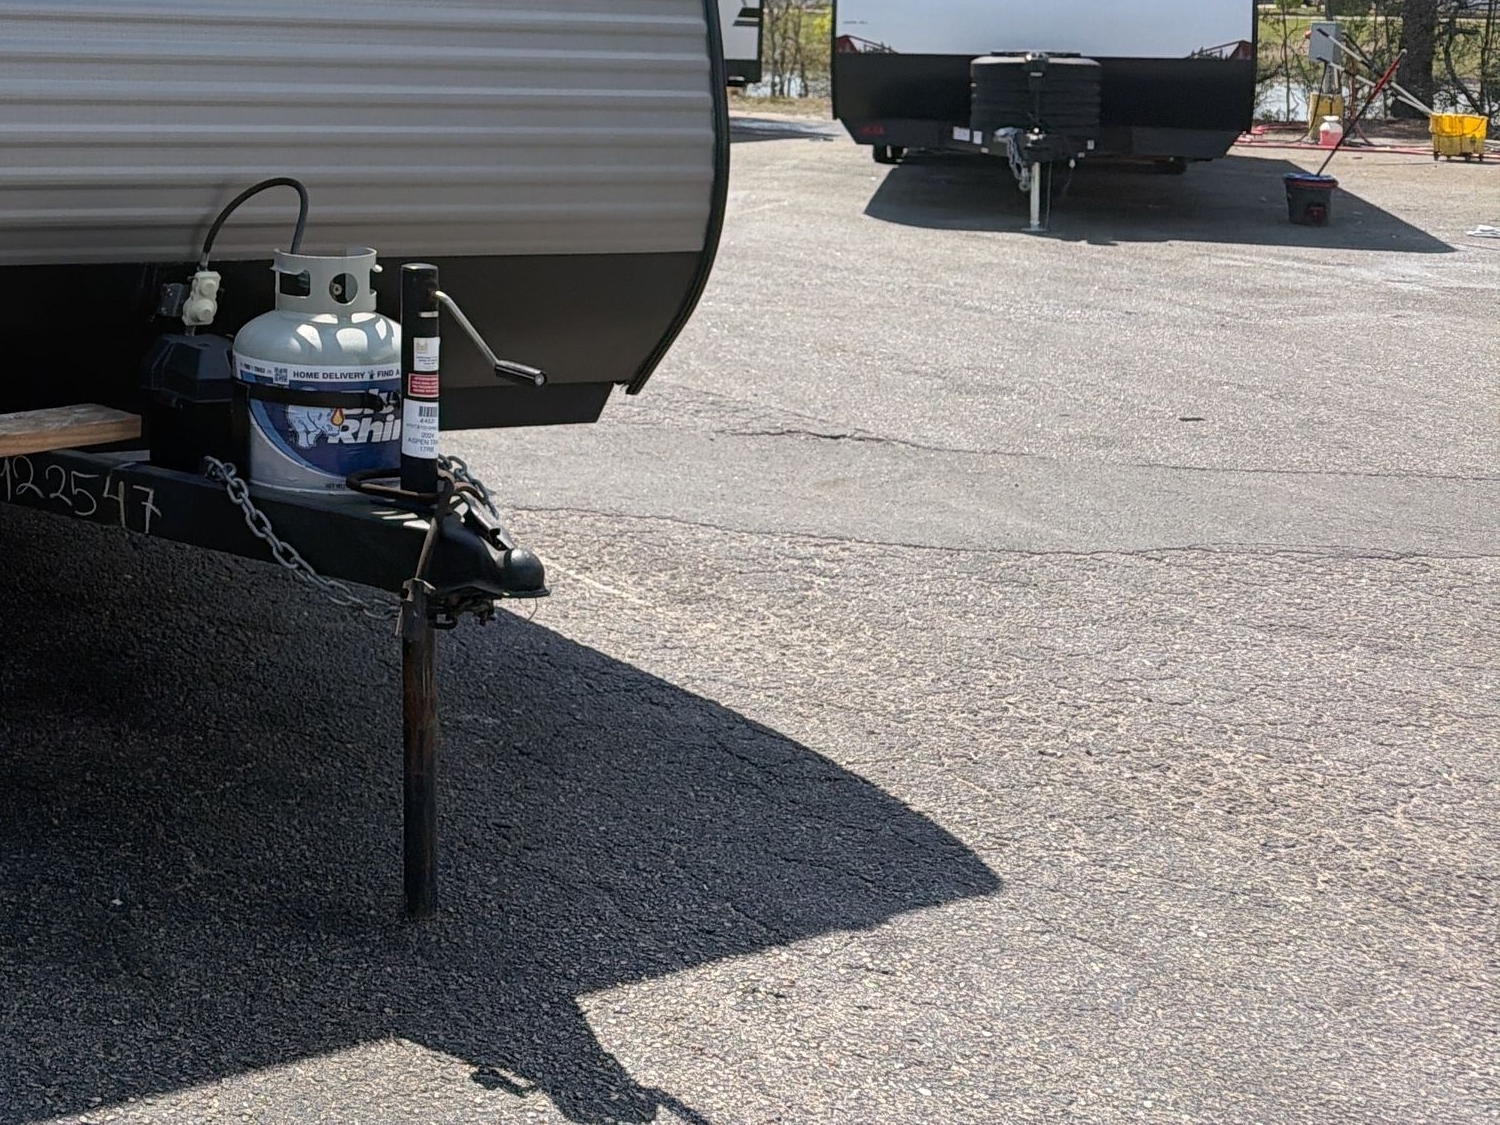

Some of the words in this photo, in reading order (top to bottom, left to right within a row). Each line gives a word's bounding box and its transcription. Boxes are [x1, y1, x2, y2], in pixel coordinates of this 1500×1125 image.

[293, 371, 320, 379] HOME
[322, 371, 366, 380] DELIVERY
[376, 369, 395, 378] FIND
